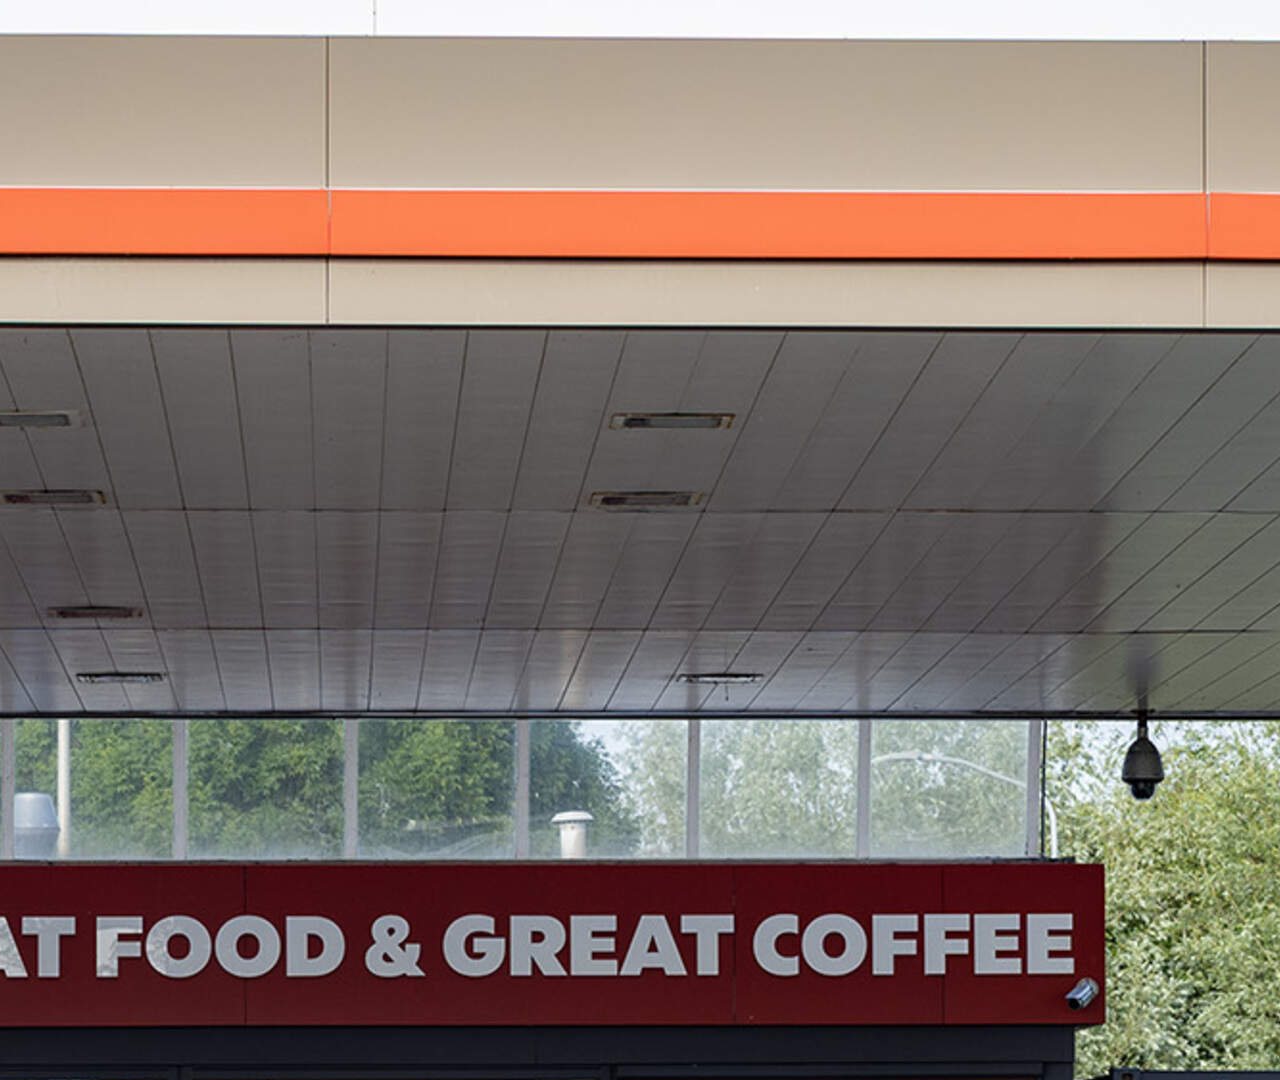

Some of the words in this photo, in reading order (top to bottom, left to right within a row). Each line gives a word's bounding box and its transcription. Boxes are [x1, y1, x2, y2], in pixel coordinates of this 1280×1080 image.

[95, 914, 347, 979] FOOD
[363, 913, 426, 978] &
[442, 913, 735, 977] GREAT
[752, 912, 1076, 976] COFFEE
